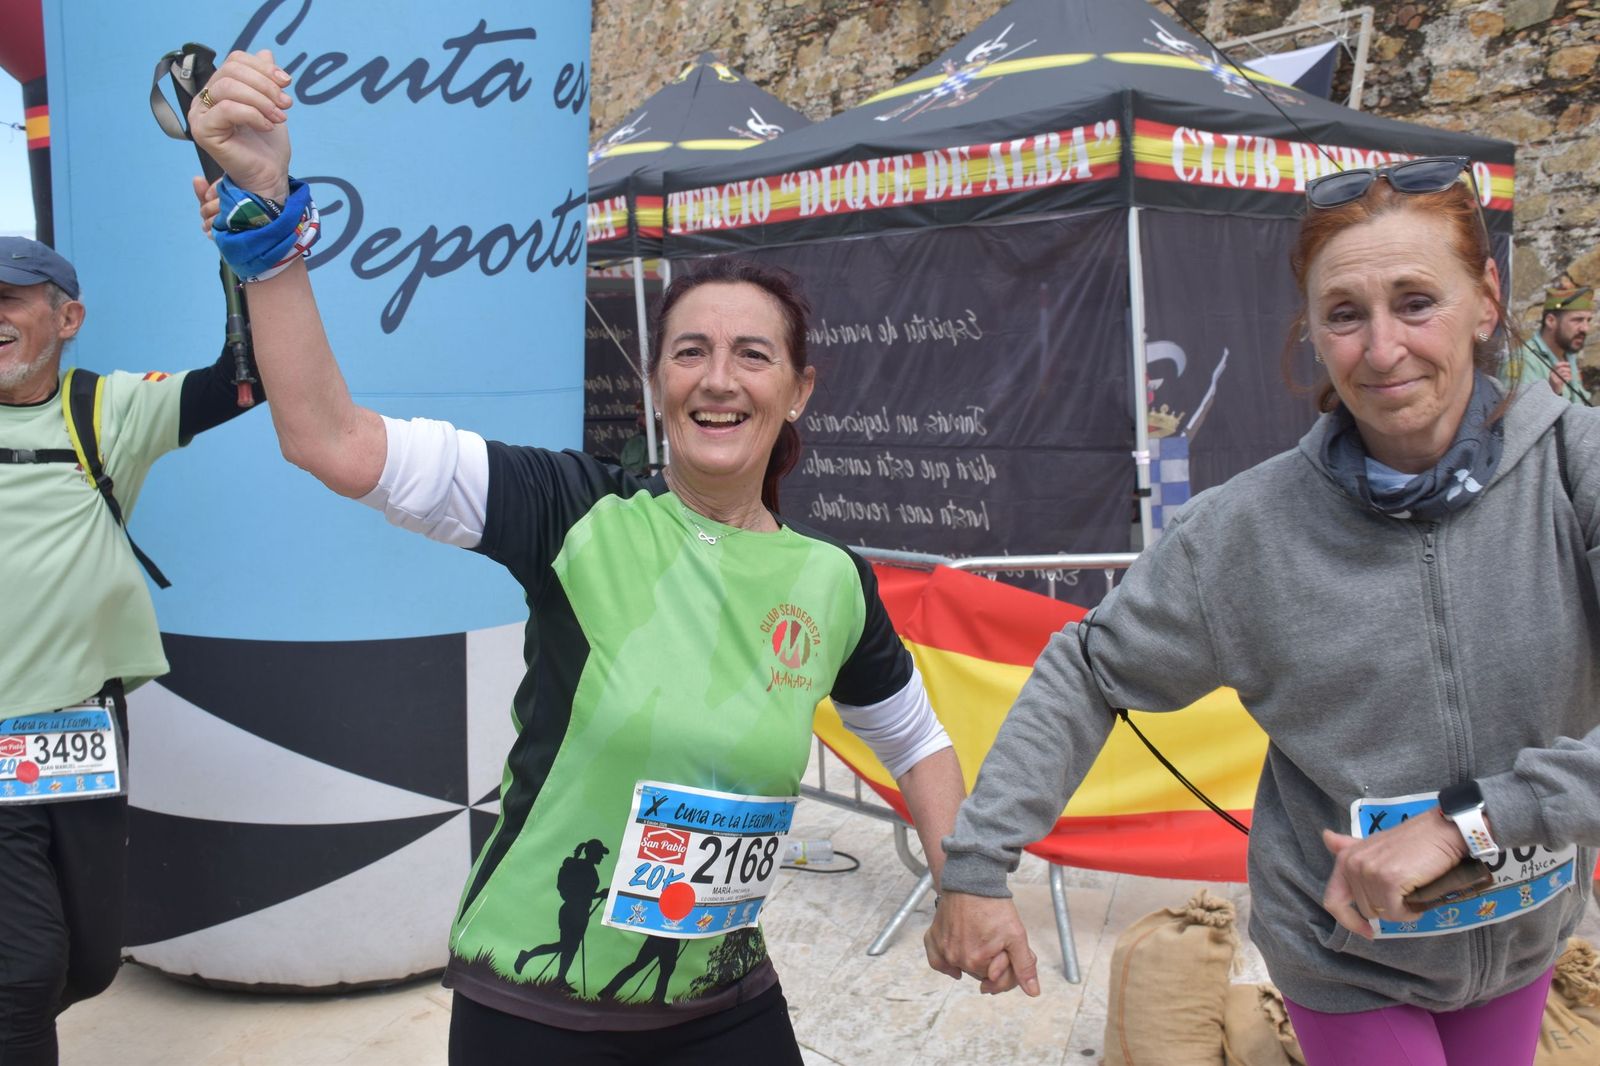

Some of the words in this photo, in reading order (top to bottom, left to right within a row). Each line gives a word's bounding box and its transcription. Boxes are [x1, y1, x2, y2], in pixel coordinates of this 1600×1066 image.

[553, 62, 589, 115] es
[1172, 126, 1281, 190] CLUB
[667, 178, 771, 234] TERCIO
[923, 146, 972, 200] DE
[760, 607, 780, 633] CLUB
[779, 603, 821, 645] SENDERISTA
[34, 732, 107, 764] 3498
[643, 795, 669, 817] X
[640, 837, 659, 848] San
[660, 840, 687, 853] Pablo
[690, 836, 779, 885] 2168
